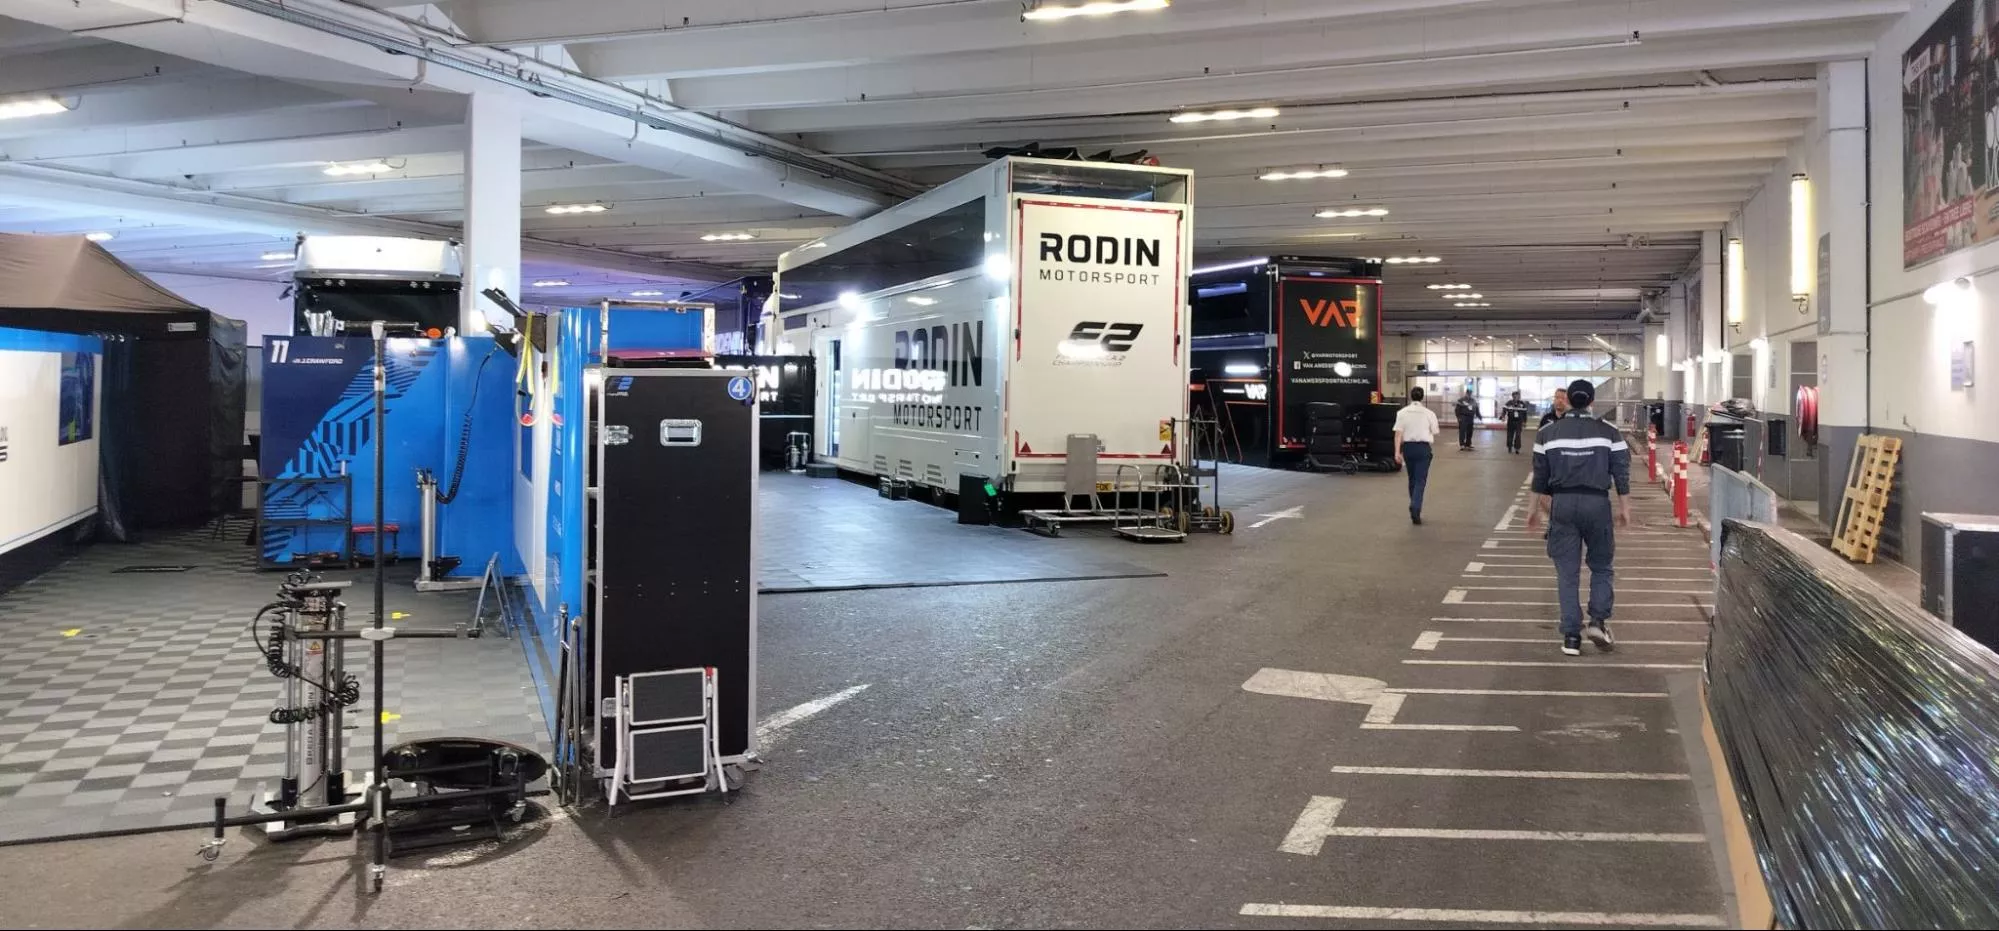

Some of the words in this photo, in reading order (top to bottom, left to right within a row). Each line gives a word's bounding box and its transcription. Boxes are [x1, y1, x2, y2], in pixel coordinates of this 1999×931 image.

[1040, 232, 1160, 267] RODIN
[1039, 269, 1160, 286] MOTORSPORT
[1300, 299, 1363, 328] VAR
[271, 340, 289, 363] 11
[731, 380, 747, 397] 4
[893, 403, 982, 432] MOTORSPORT
